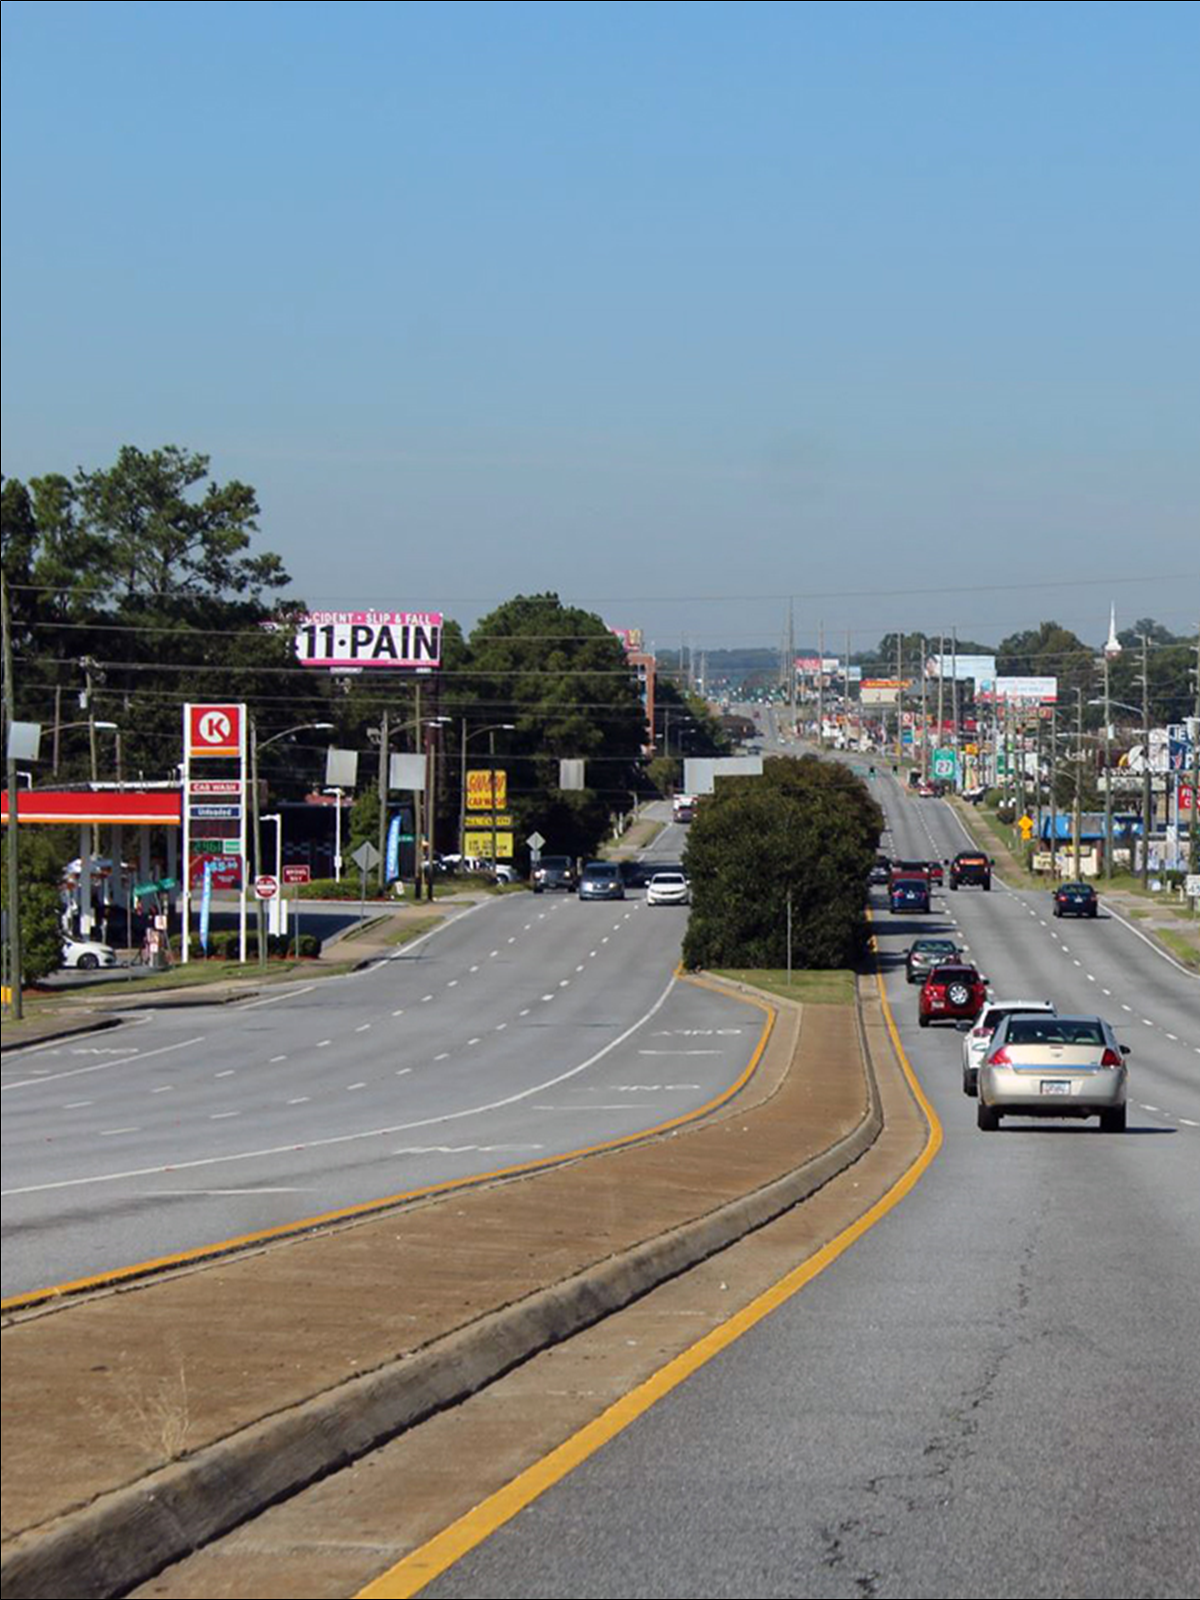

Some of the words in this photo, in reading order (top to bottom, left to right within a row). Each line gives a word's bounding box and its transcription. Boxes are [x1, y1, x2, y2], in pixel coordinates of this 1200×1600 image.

[366, 613, 390, 624] SLIP
[394, 614, 401, 623] &
[405, 613, 431, 625] FALL
[208, 718, 227, 742] K
[936, 761, 953, 774] 27
